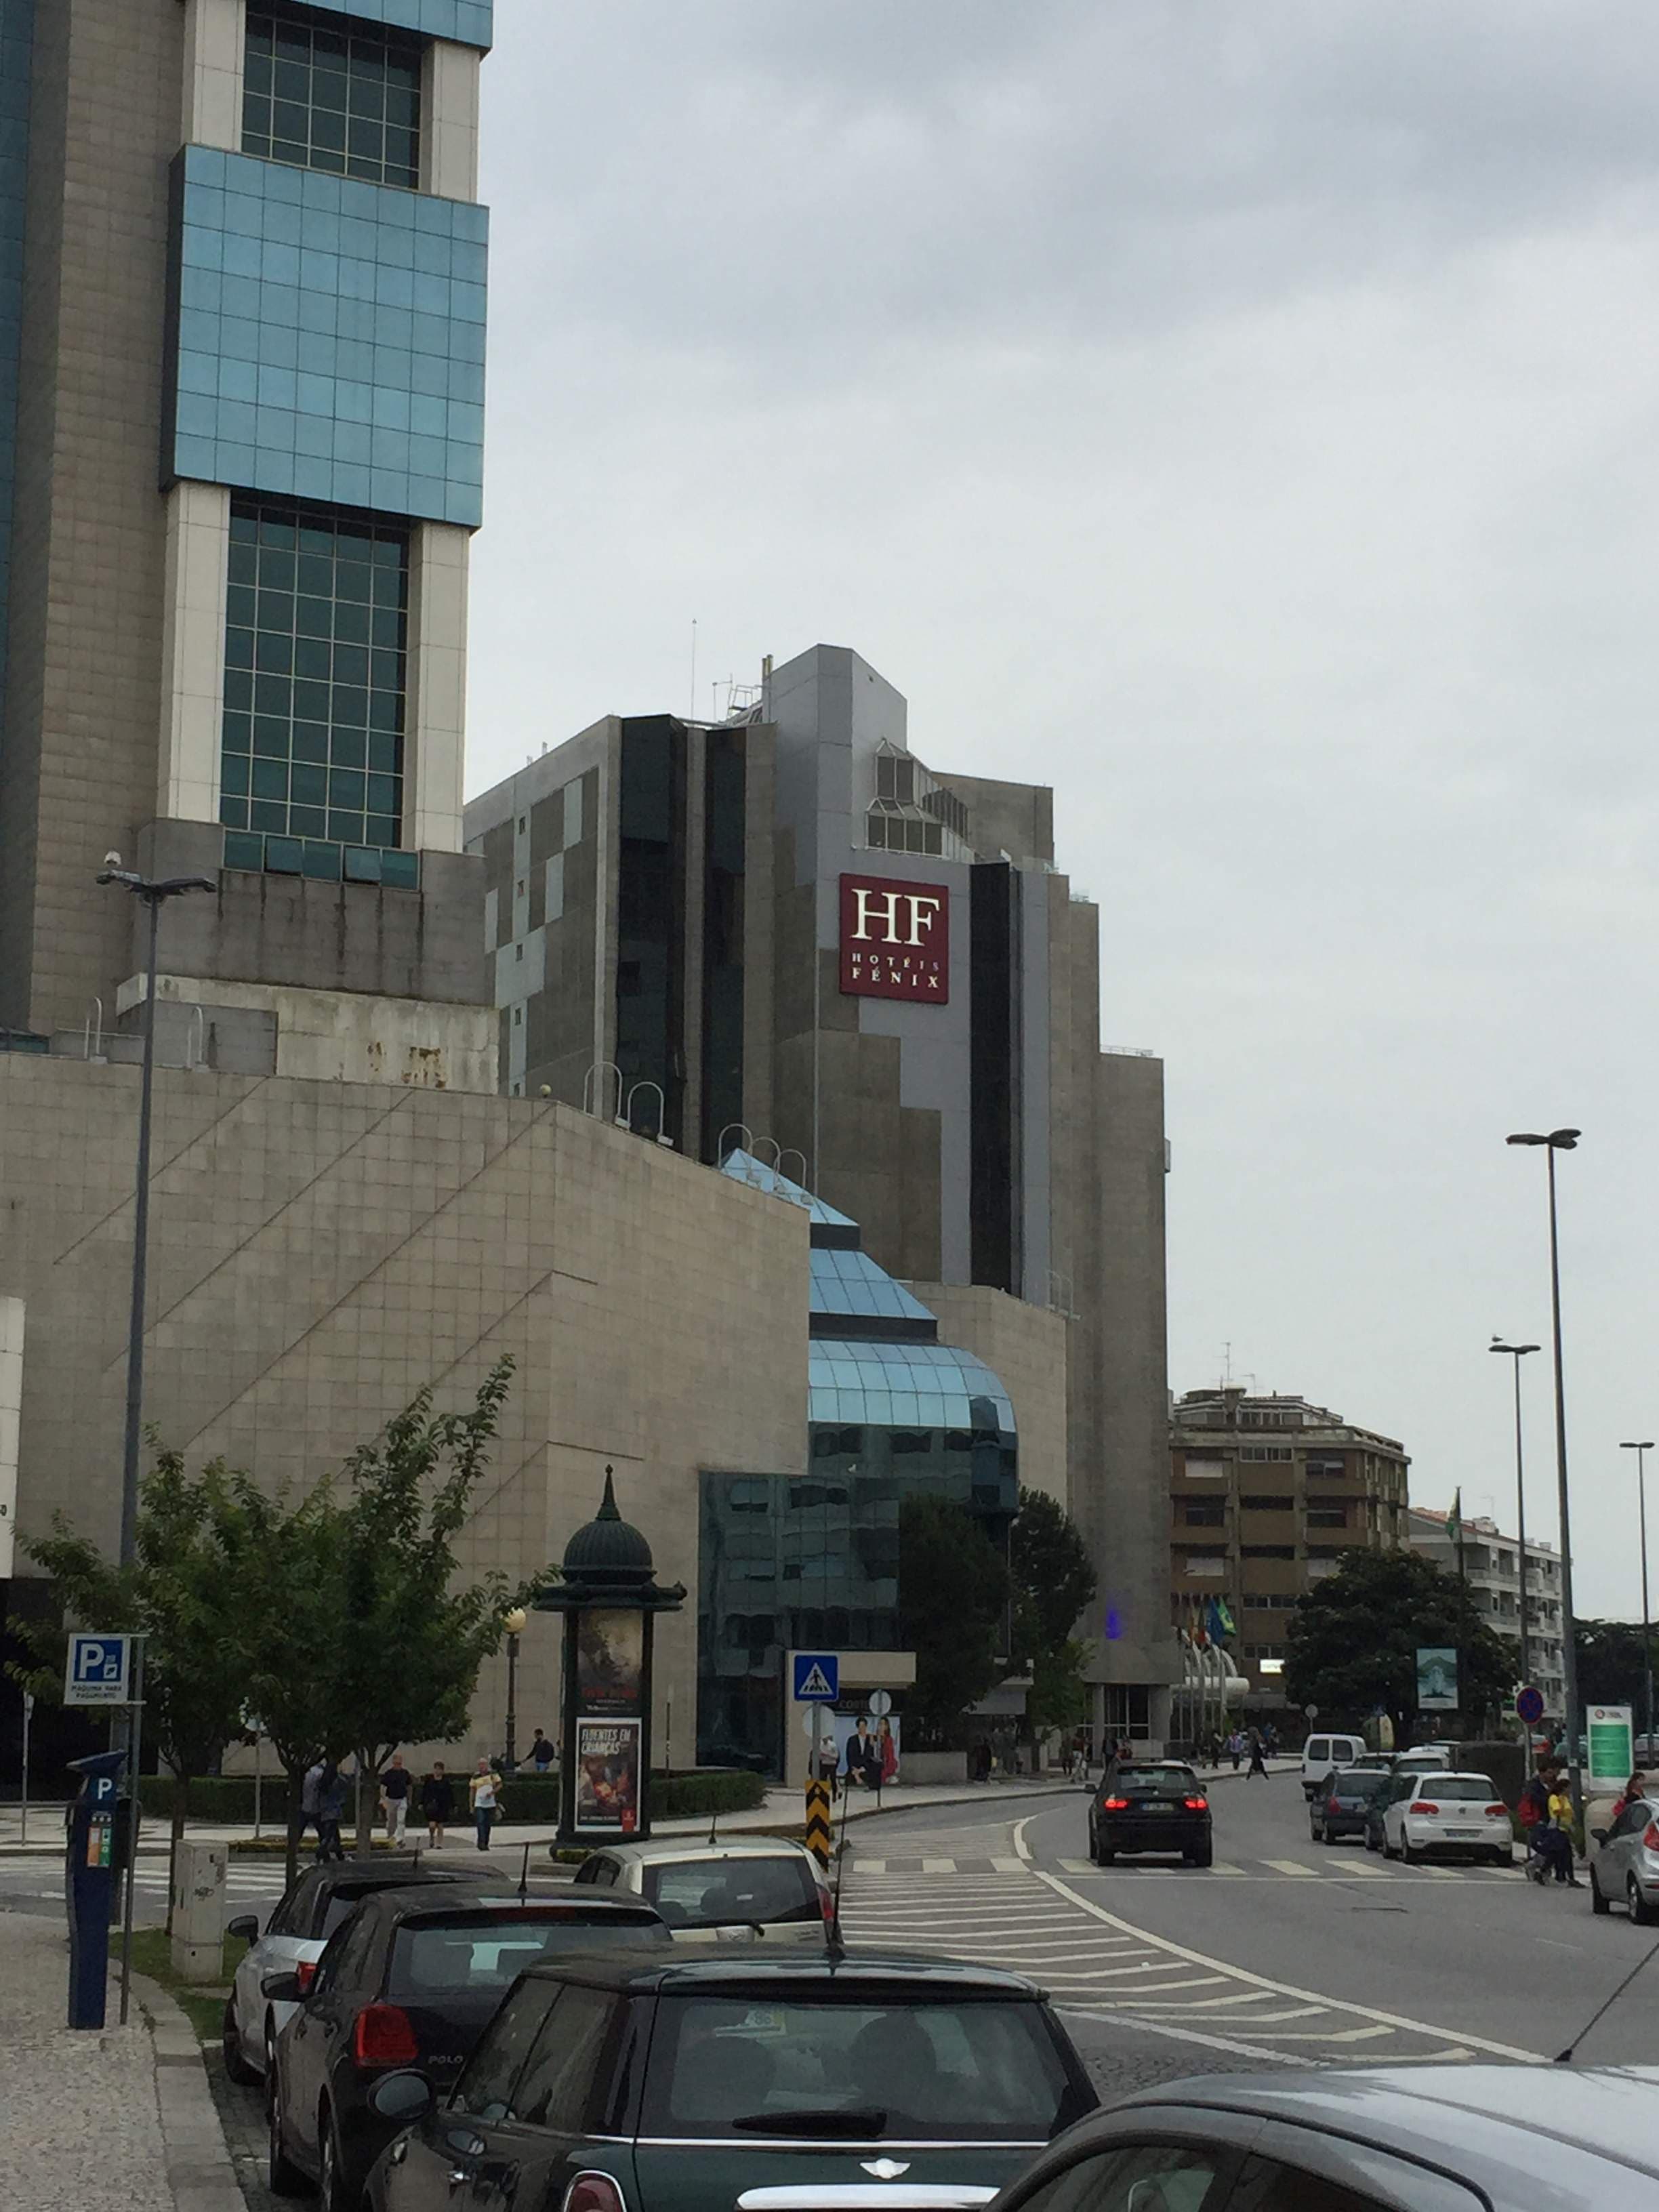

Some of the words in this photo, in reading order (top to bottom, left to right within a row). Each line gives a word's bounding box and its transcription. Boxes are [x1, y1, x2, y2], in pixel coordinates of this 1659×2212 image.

[850, 888, 940, 947] HF
[852, 966, 939, 989] FÉNIX
[79, 1643, 104, 1679] P
[98, 1778, 112, 1800] P
[428, 2055, 464, 2065] POLO
